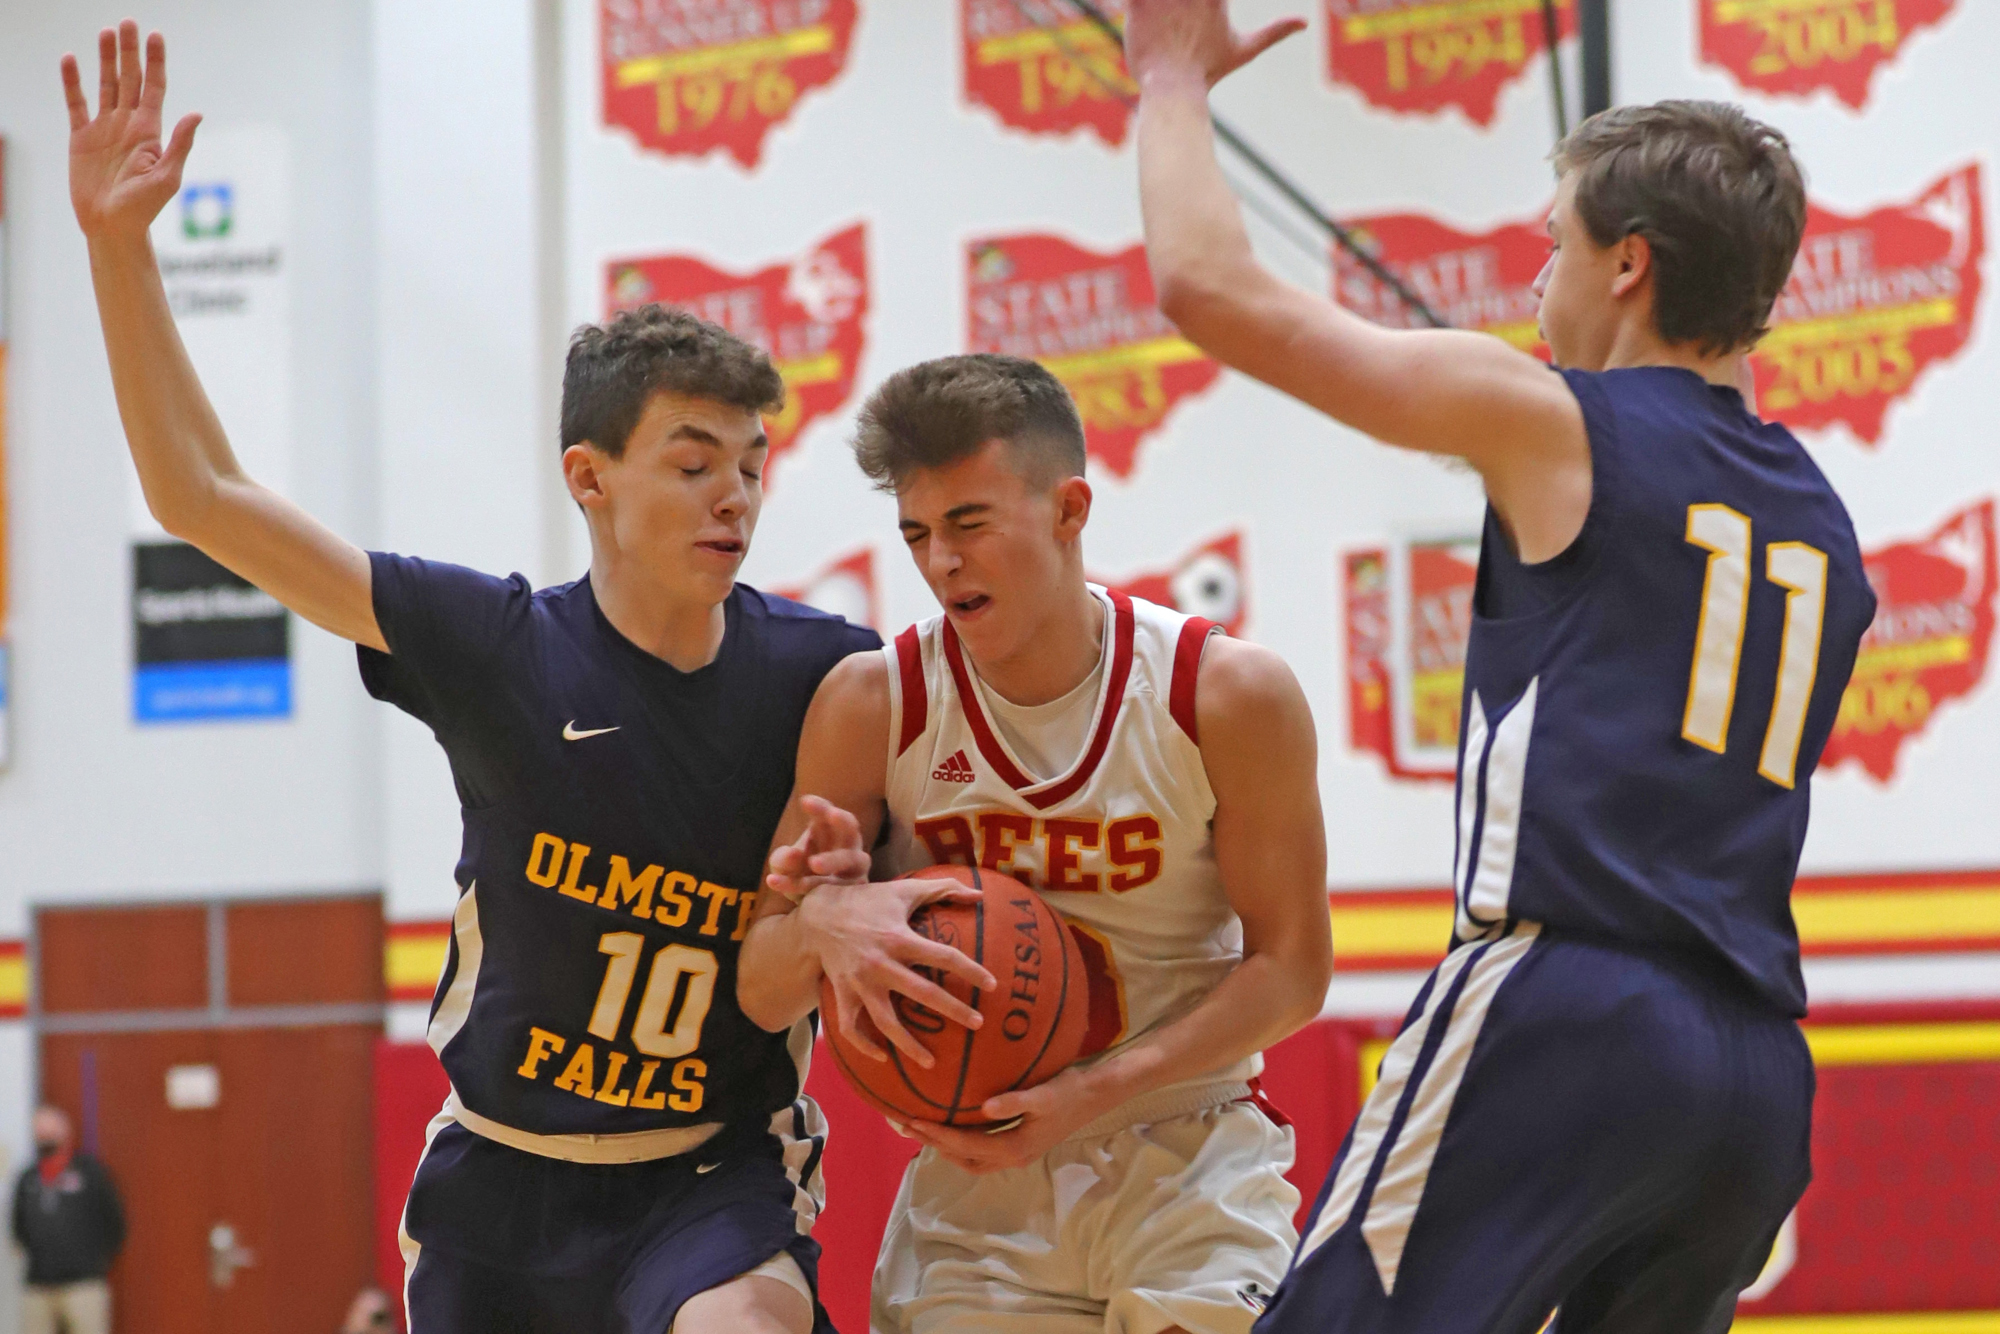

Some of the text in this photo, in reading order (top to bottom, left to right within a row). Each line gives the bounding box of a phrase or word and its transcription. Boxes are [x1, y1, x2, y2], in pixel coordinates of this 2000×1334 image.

[1384, 16, 1526, 90] 1994
[1749, 0, 1898, 75] 2004
[655, 58, 797, 134] 1976
[1763, 336, 1912, 411] 2005
[1681, 502, 1829, 791] 11
[932, 769, 976, 783] adidas
[587, 931, 719, 1058] 10
[1001, 899, 1042, 1041] OHSAA
[517, 1026, 708, 1113] FALLS
